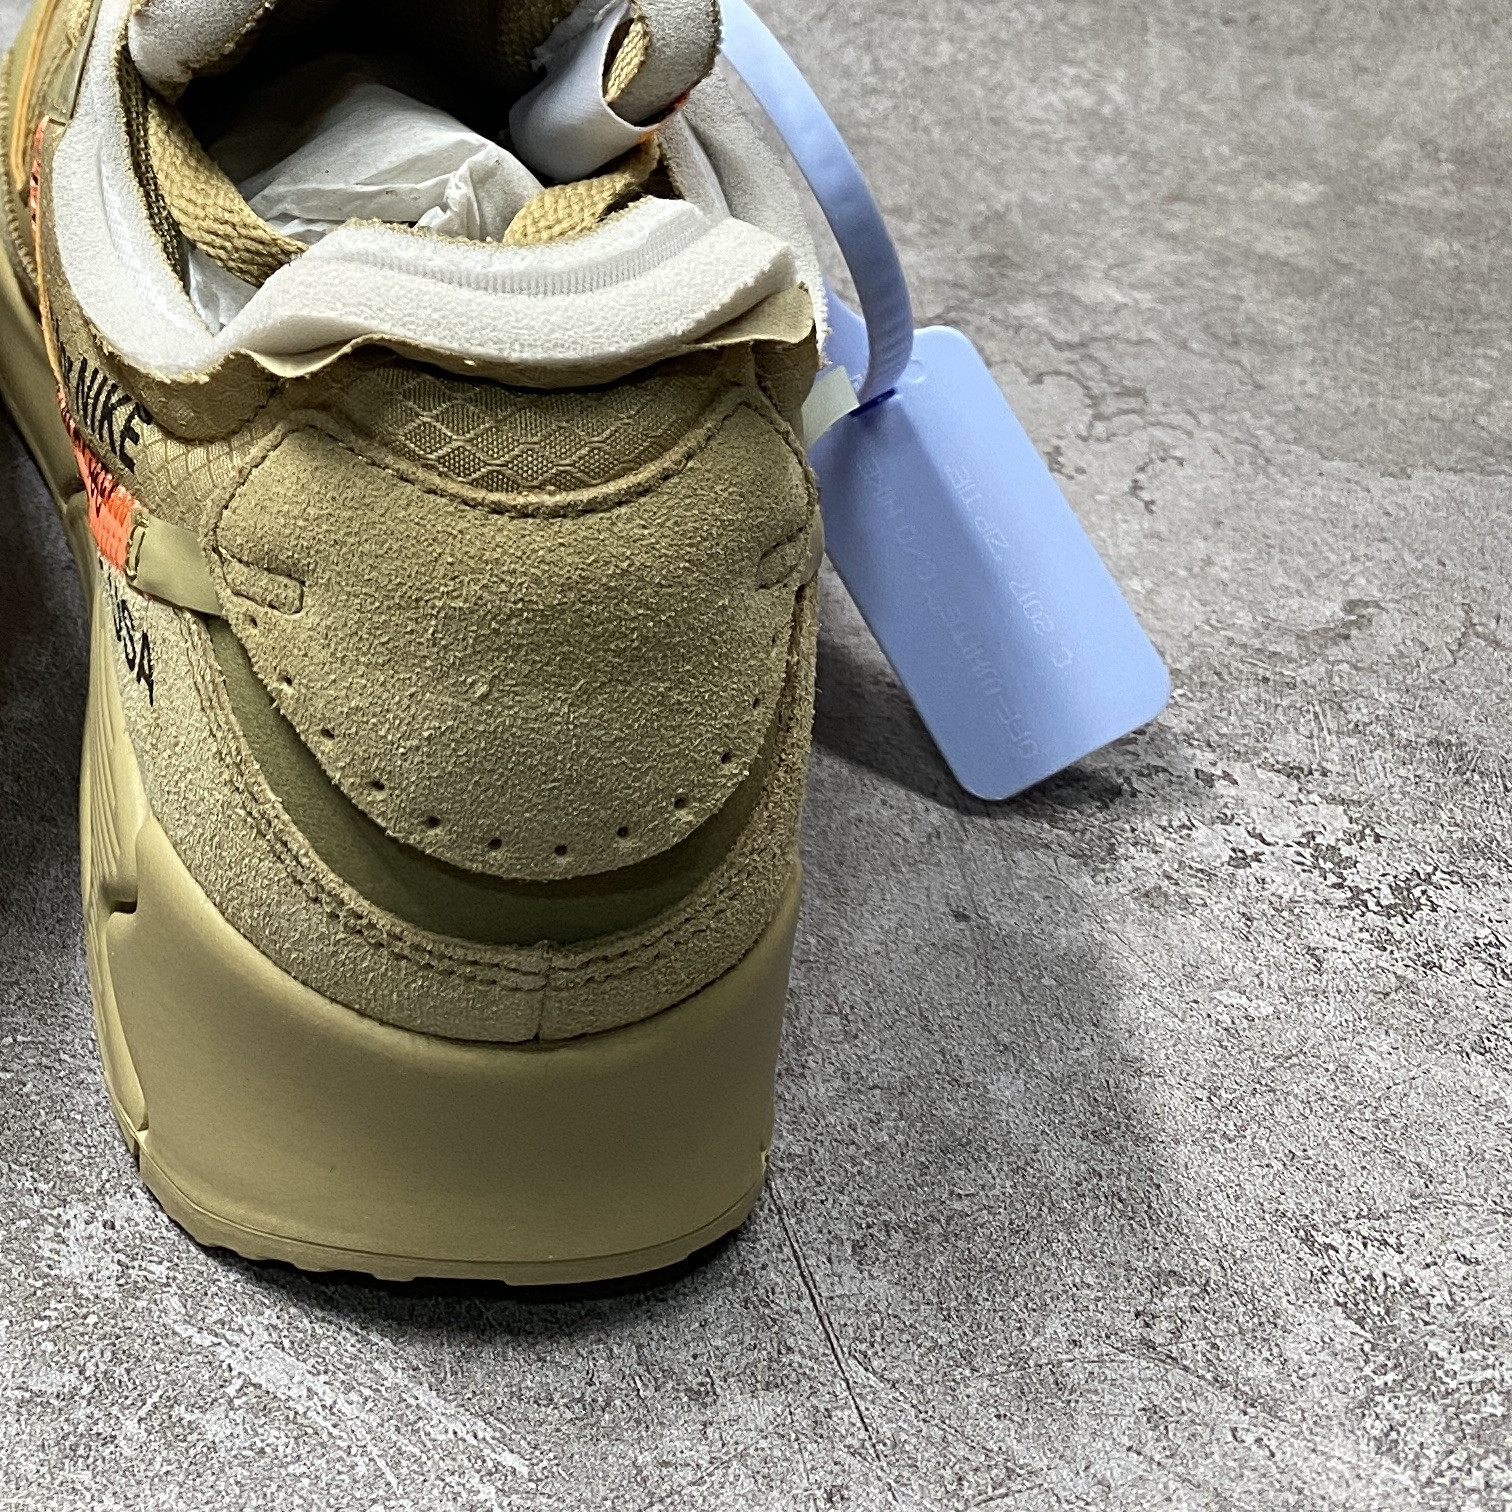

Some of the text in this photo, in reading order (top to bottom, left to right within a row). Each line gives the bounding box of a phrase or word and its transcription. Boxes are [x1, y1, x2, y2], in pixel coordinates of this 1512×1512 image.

[76, 356, 154, 475] NIKE
[111, 586, 155, 708] USA
[1010, 575, 1054, 636] 2017
